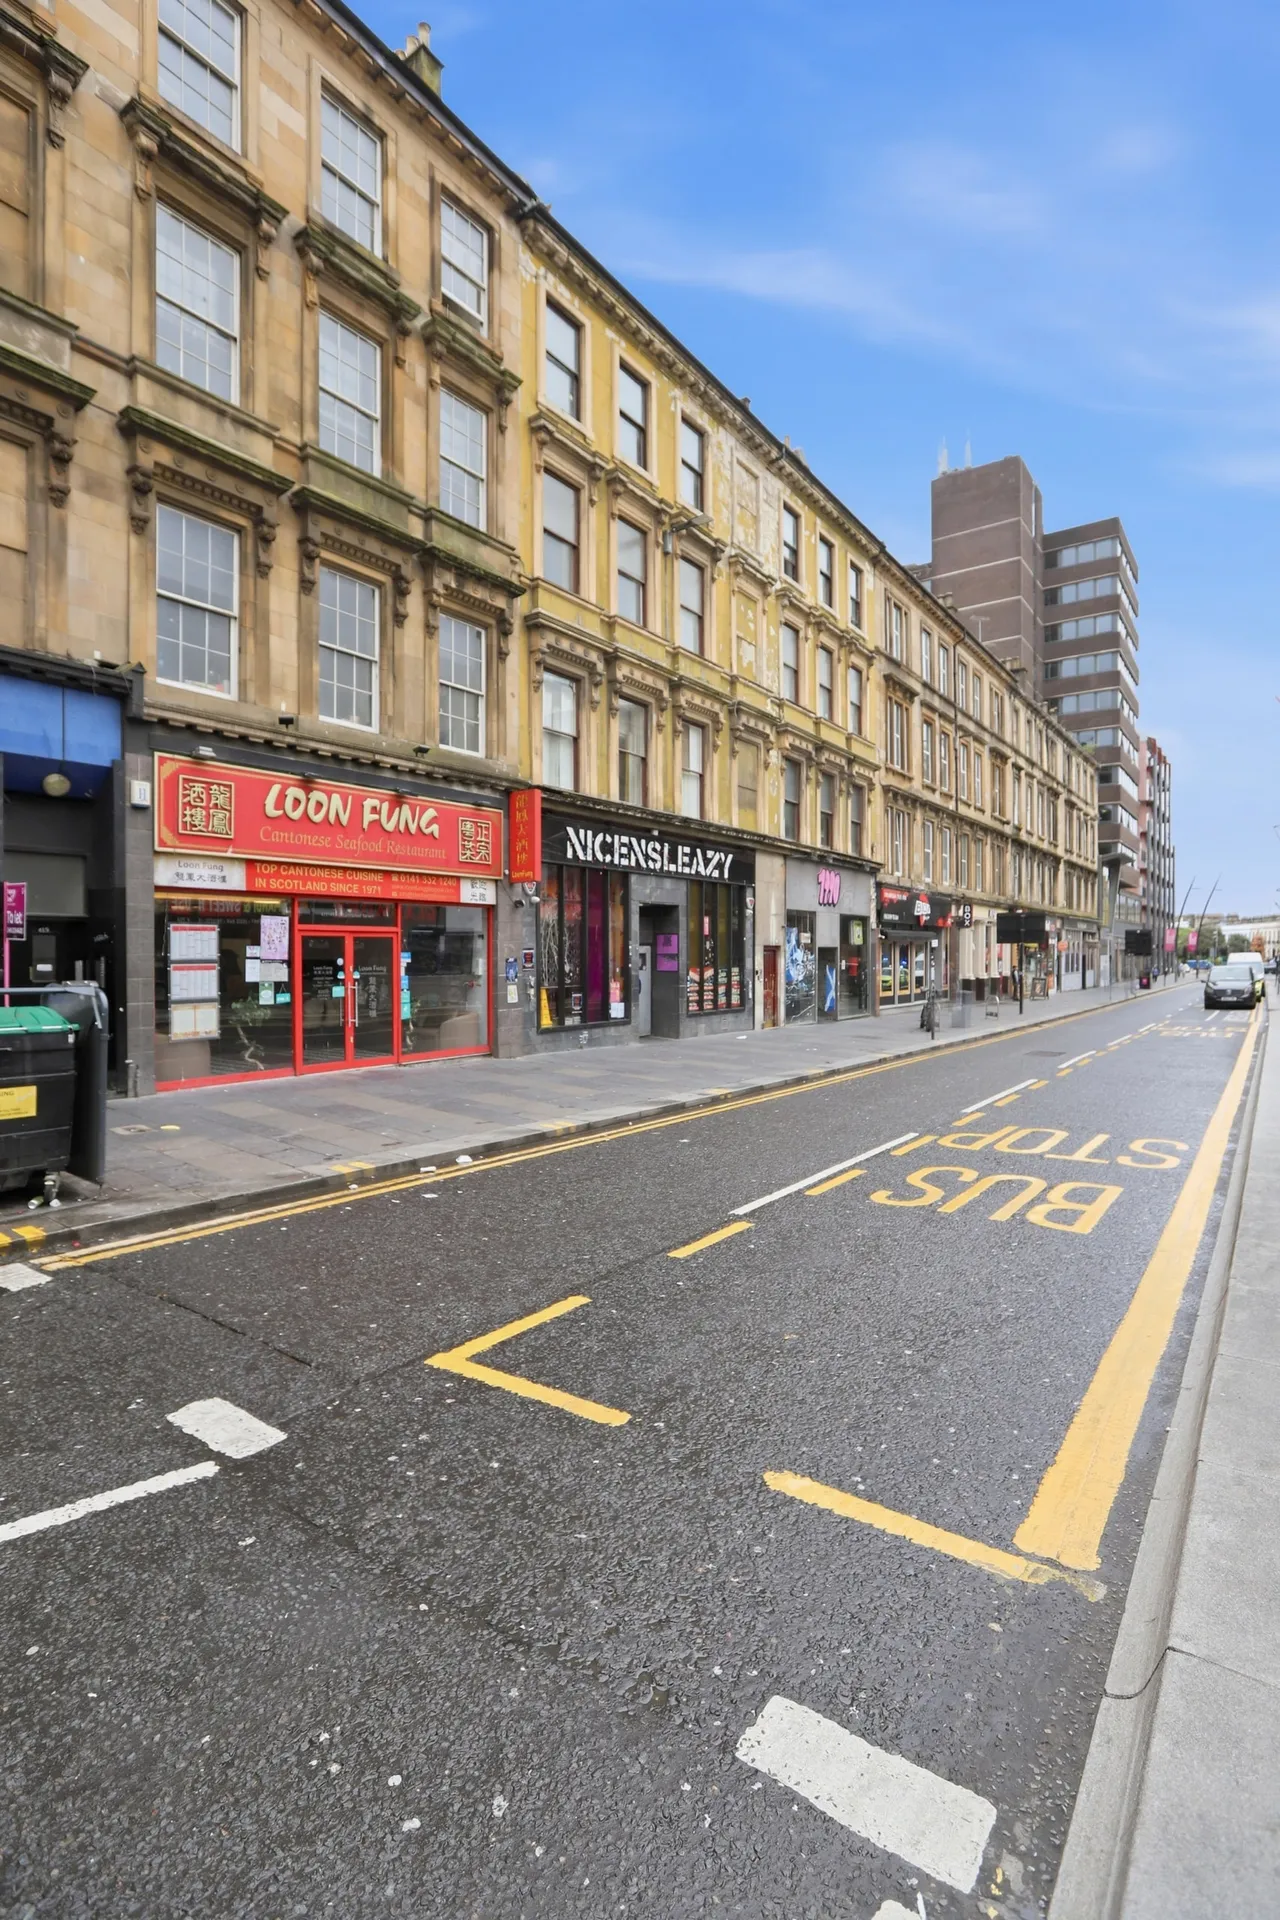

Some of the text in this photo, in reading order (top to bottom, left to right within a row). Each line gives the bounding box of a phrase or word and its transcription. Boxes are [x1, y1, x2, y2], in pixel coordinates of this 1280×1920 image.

[264, 783, 440, 840] LOON FUNG
[259, 826, 447, 860] Cantonese Seafood Restaurant
[177, 860, 224, 873] Loon Fung
[255, 863, 384, 882] TOP CANTONESE CUISINE
[255, 877, 266, 888] IN
[269, 878, 328, 891] SCOTLAND
[330, 882, 359, 893] SINCE
[362, 885, 382, 895] 1971
[963, 905, 972, 927] BOX
[937, 1126, 1190, 1169] STOP
[870, 1166, 1125, 1235] BUS
